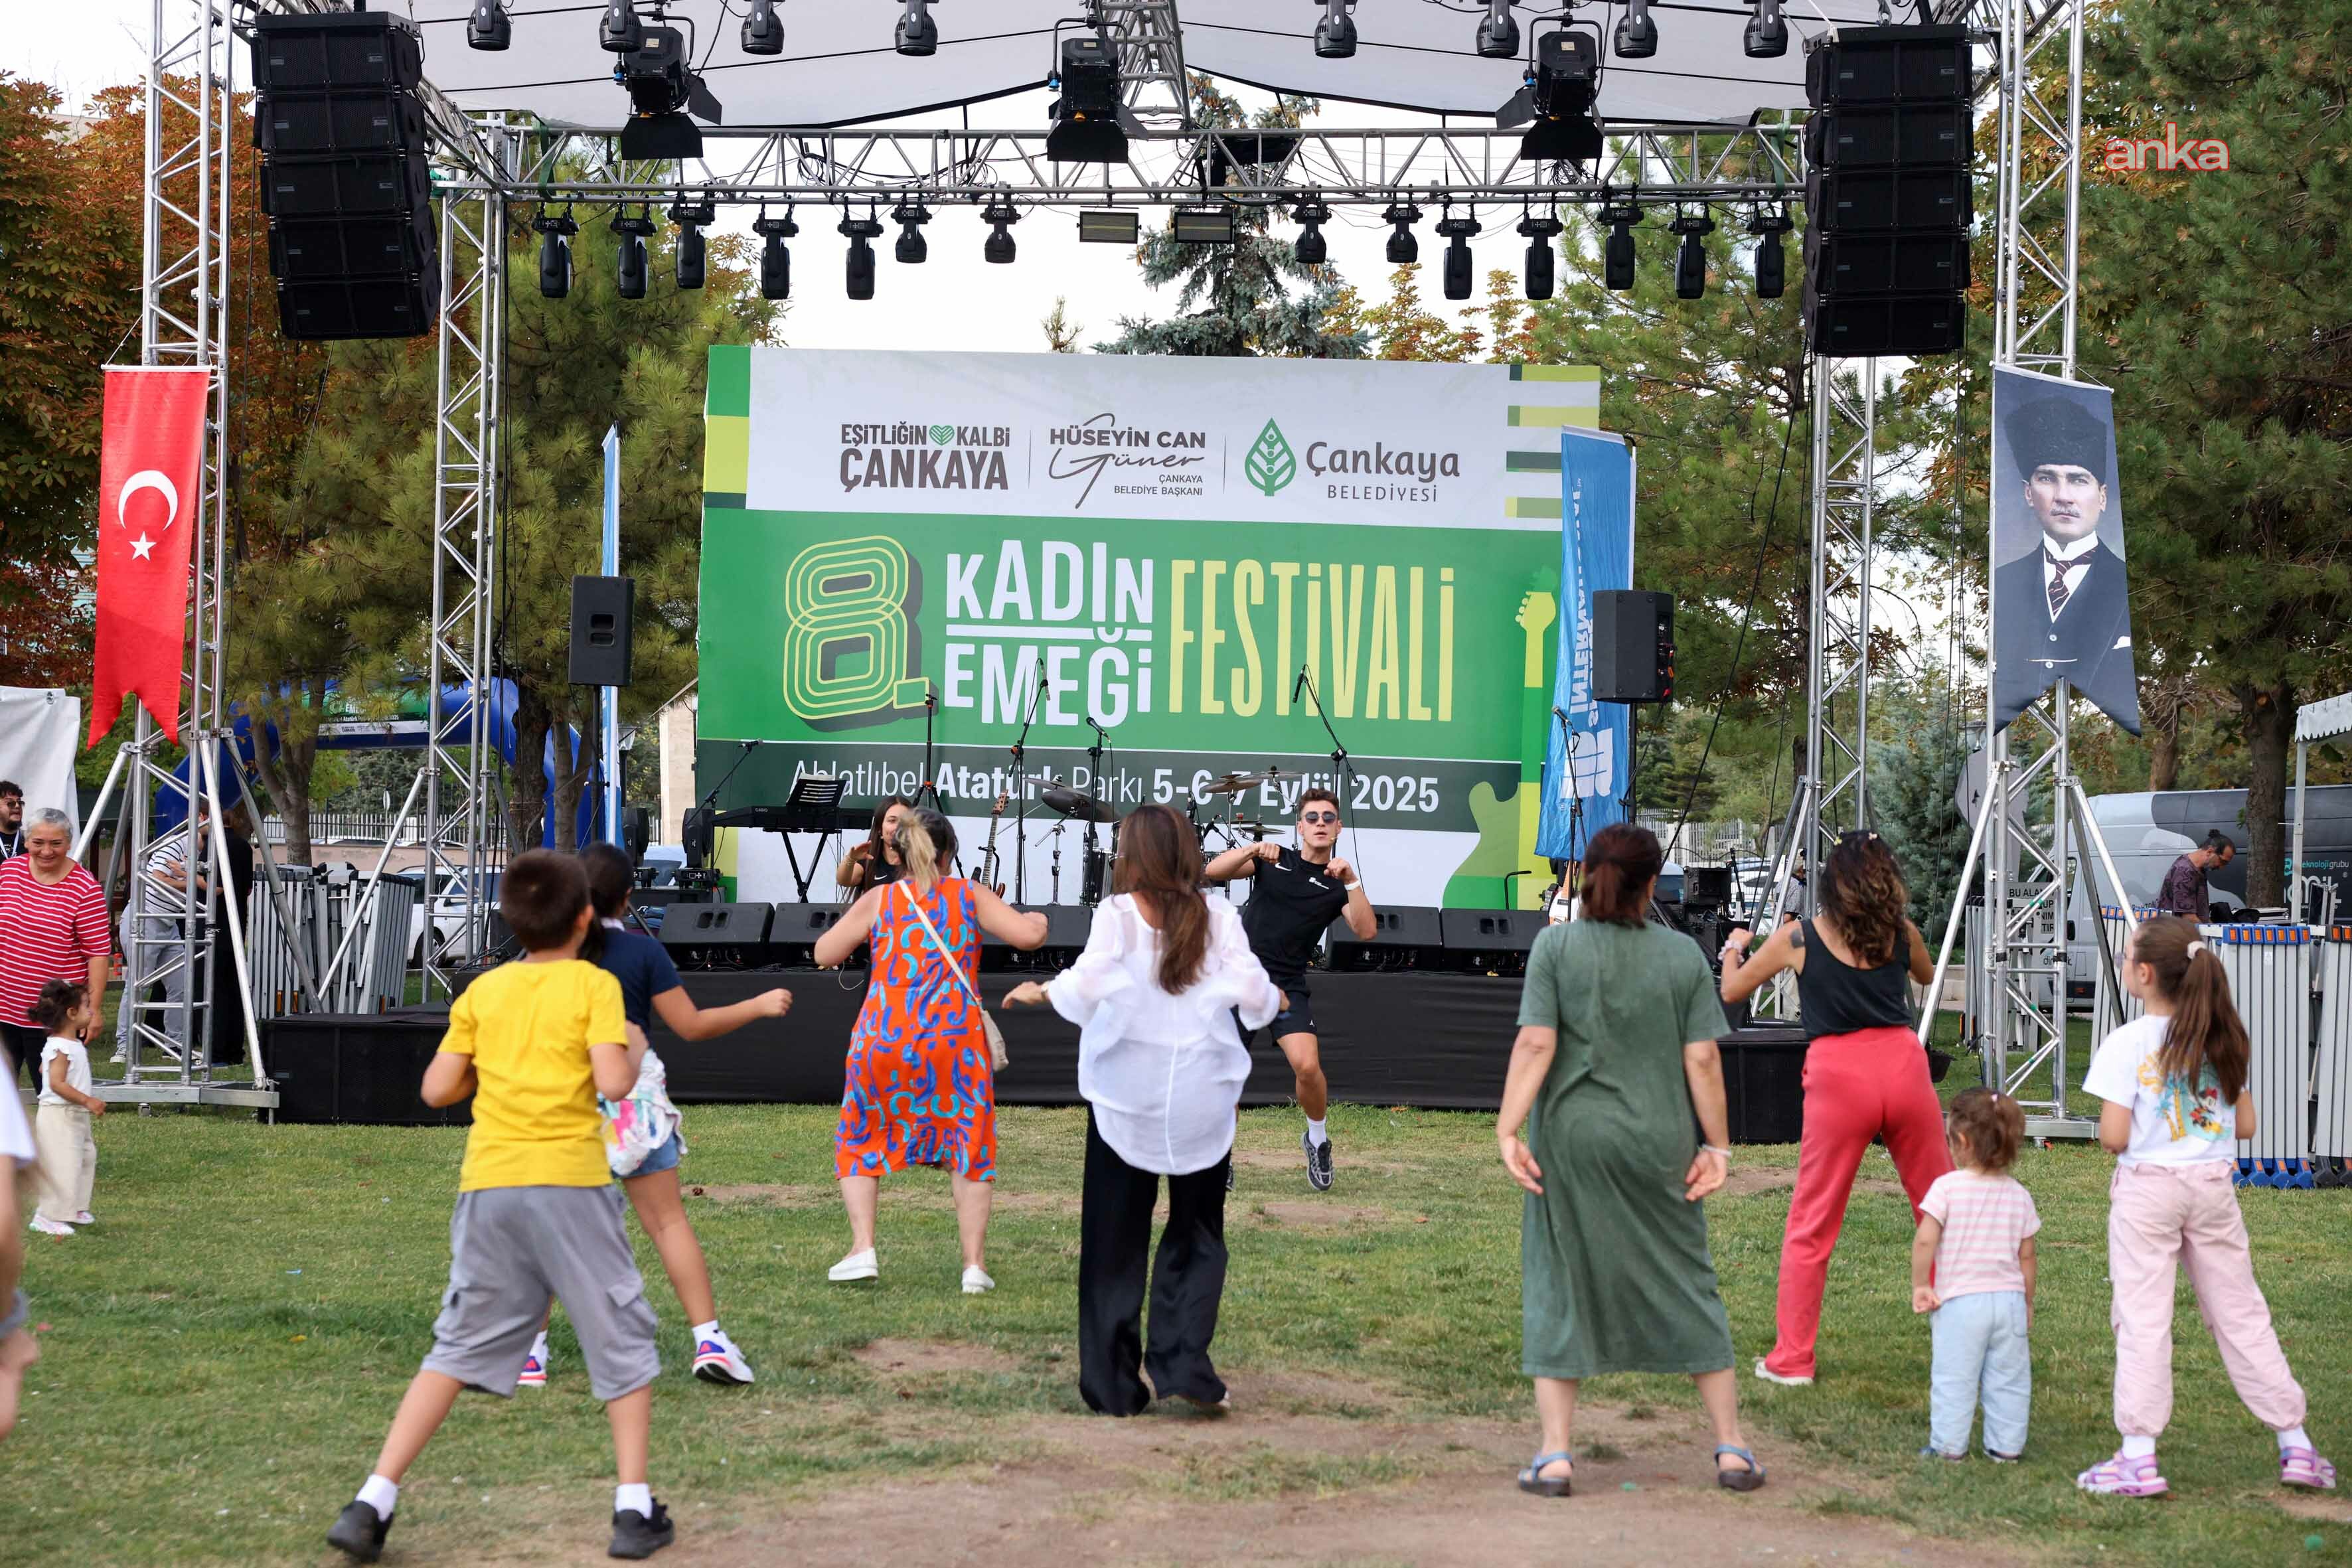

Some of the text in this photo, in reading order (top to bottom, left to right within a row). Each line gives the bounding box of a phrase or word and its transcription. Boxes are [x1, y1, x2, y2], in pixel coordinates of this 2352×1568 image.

[1050, 425, 1206, 449] HÜSEYİN CAN
[840, 448, 1009, 493] ÇANKAYA
[1048, 412, 1205, 510] Güner
[1158, 474, 1203, 485] ÇANKAYA
[1306, 441, 1460, 483] Çankaya
[1114, 485, 1203, 497] BELEDİYE BAŞKANI
[1327, 483, 1437, 503] BELEDİYESİ
[946, 539, 1154, 623] KADIN
[783, 534, 931, 720] 8.
[1071, 766, 1143, 803] Parkı
[1350, 773, 1439, 813] 2025
[2009, 888, 2043, 898] BU ALA
